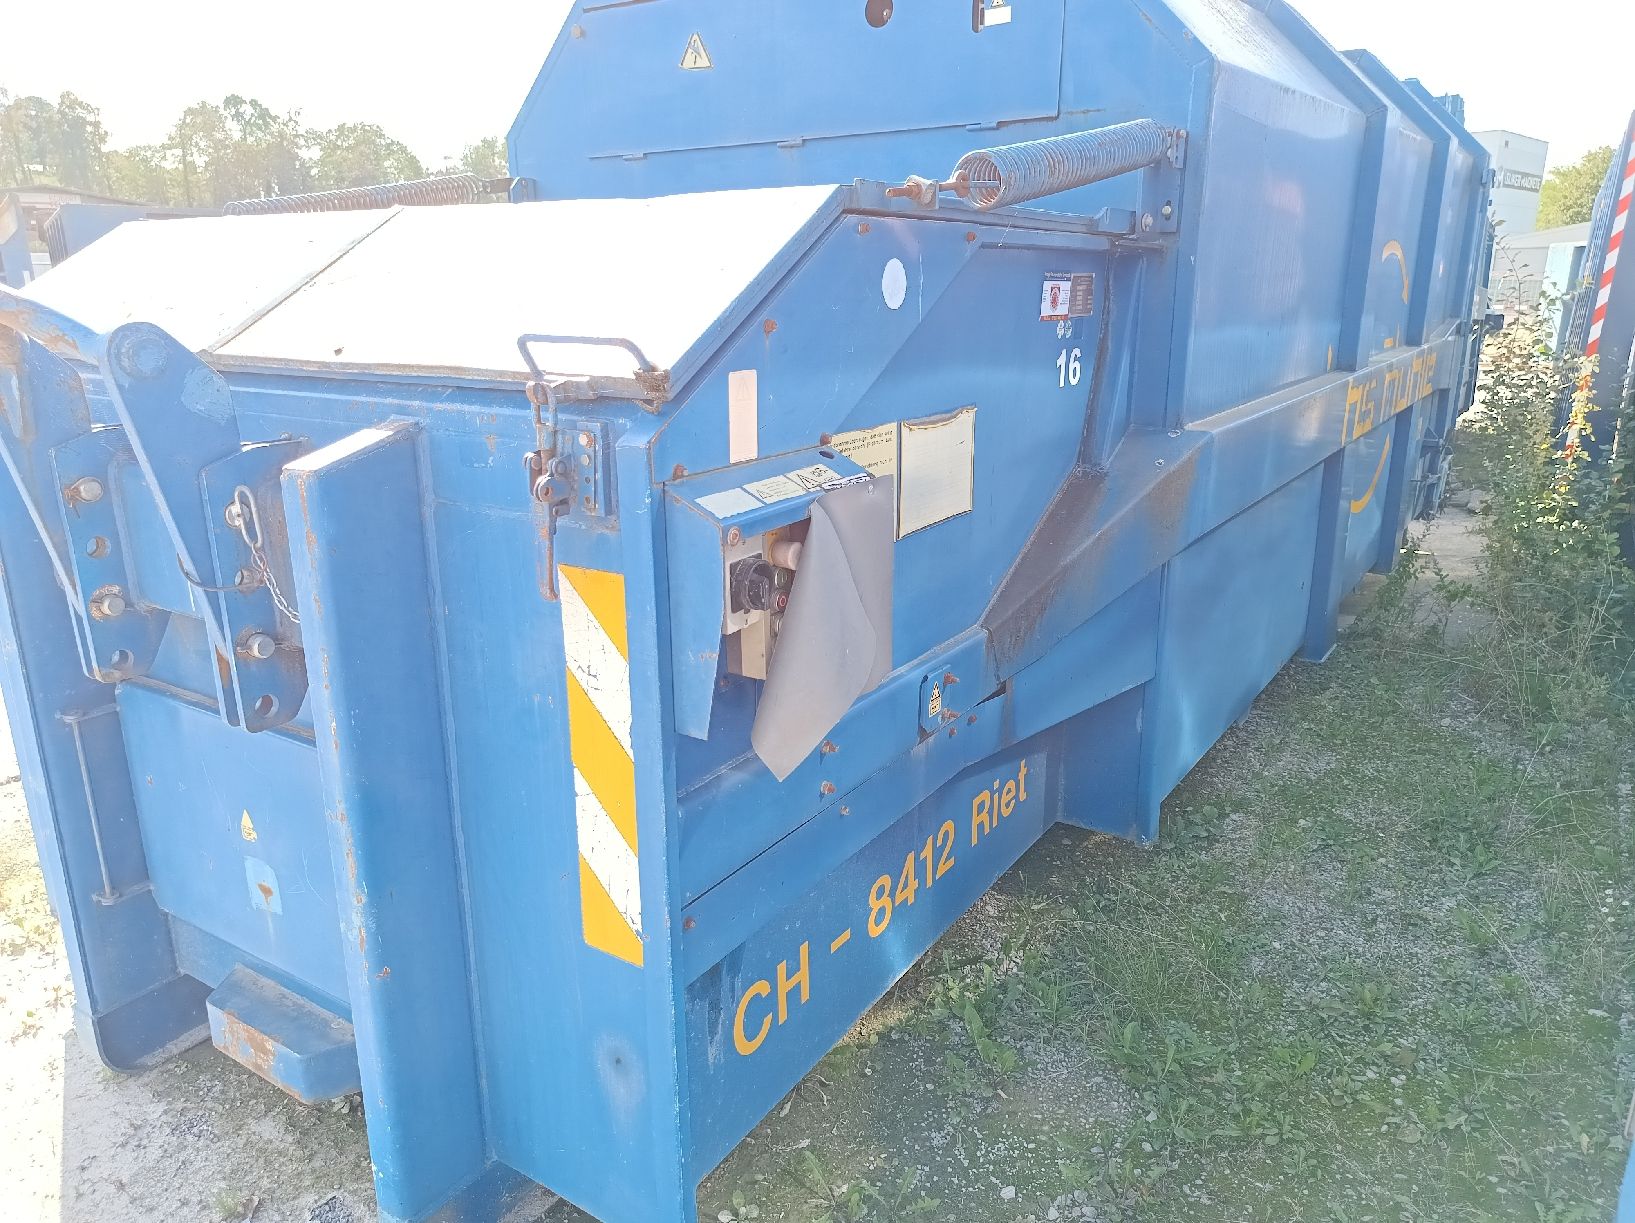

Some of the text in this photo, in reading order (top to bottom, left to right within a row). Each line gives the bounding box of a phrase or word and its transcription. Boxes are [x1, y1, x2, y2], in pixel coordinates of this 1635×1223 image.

[1056, 347, 1082, 388] 16
[733, 940, 810, 1056] CH
[867, 819, 955, 938] 8412
[971, 758, 1028, 848] Riet
